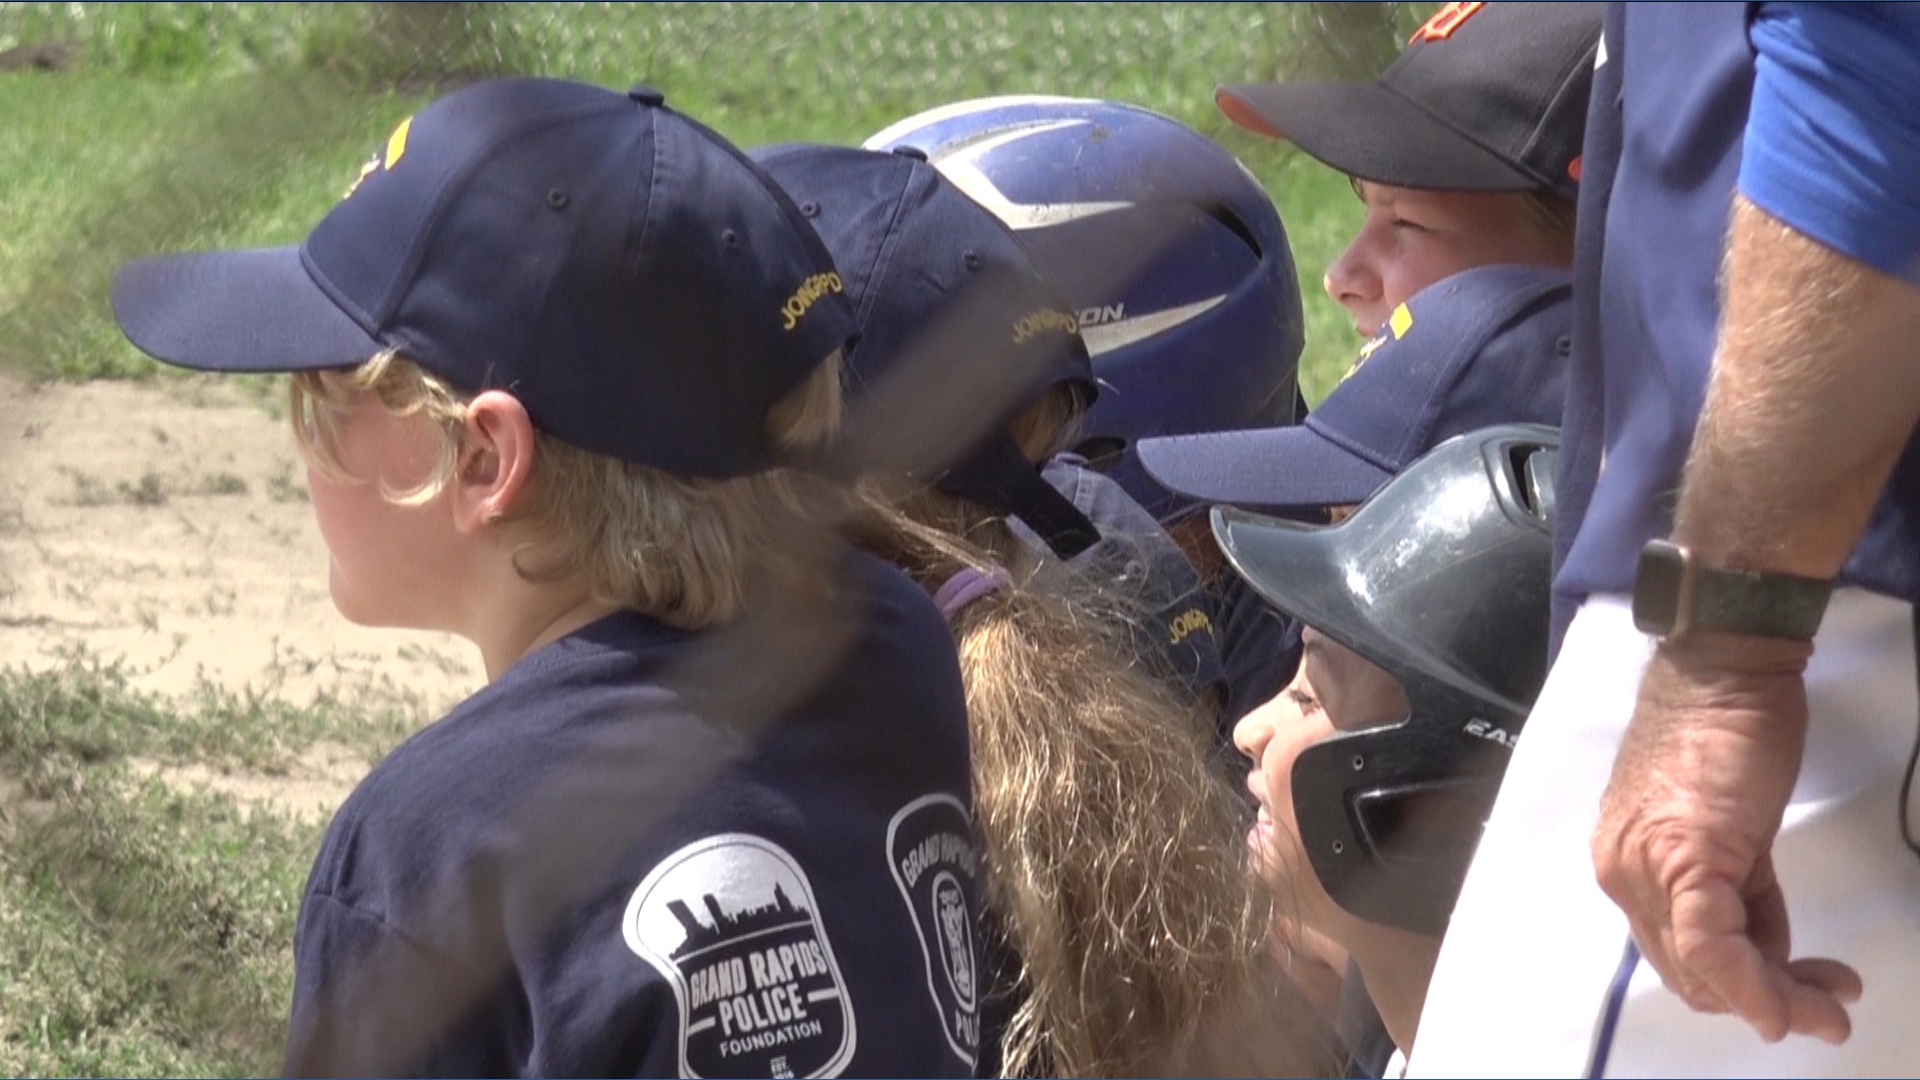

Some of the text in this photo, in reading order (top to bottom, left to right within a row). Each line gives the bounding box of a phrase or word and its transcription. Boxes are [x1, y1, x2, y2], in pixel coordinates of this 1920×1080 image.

[901, 833, 940, 888] GRAND
[690, 939, 828, 1010] GRAND RAPIDS
[718, 983, 808, 1036] POLICE
[719, 1018, 823, 1058] FOUNDATION
